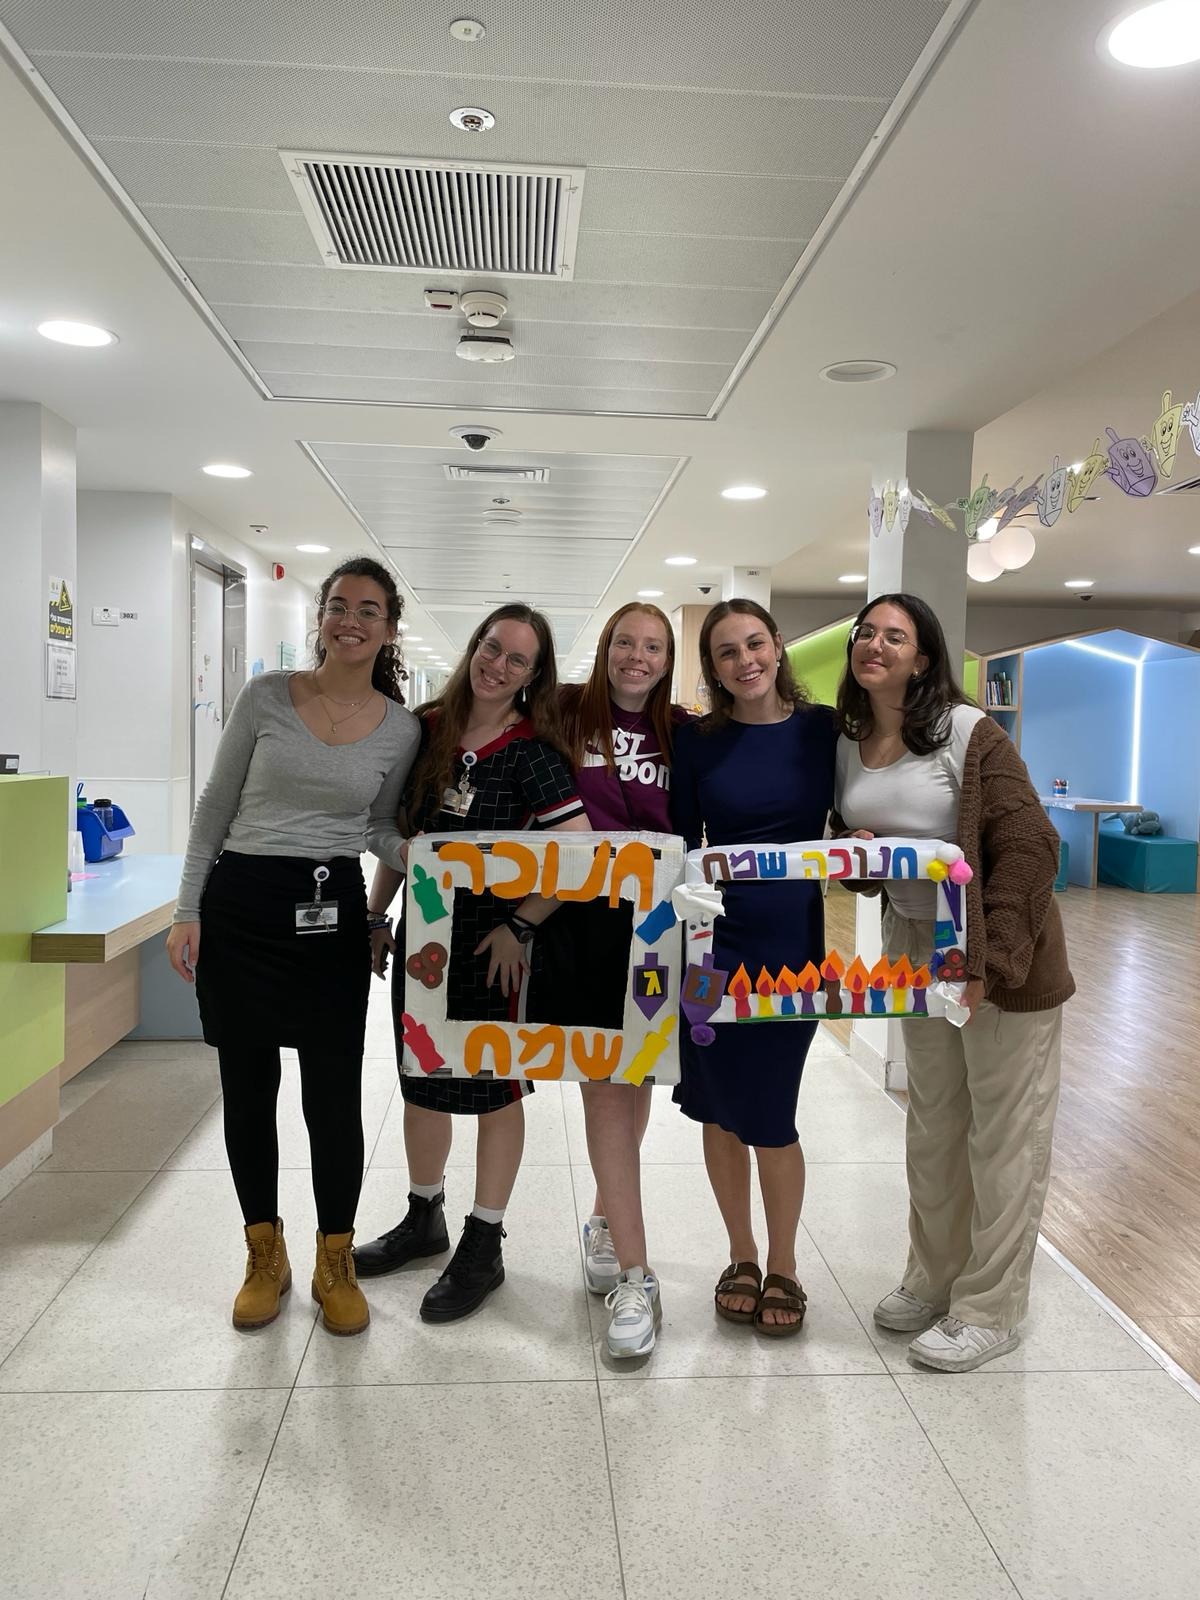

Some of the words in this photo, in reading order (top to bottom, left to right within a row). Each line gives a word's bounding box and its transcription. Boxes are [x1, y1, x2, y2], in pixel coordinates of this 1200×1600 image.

[438, 840, 655, 911] חנוכה
[702, 850, 788, 884] שמח
[802, 846, 918, 880] חנוכה
[643, 971, 662, 996] ג
[464, 1024, 623, 1080] שמח
